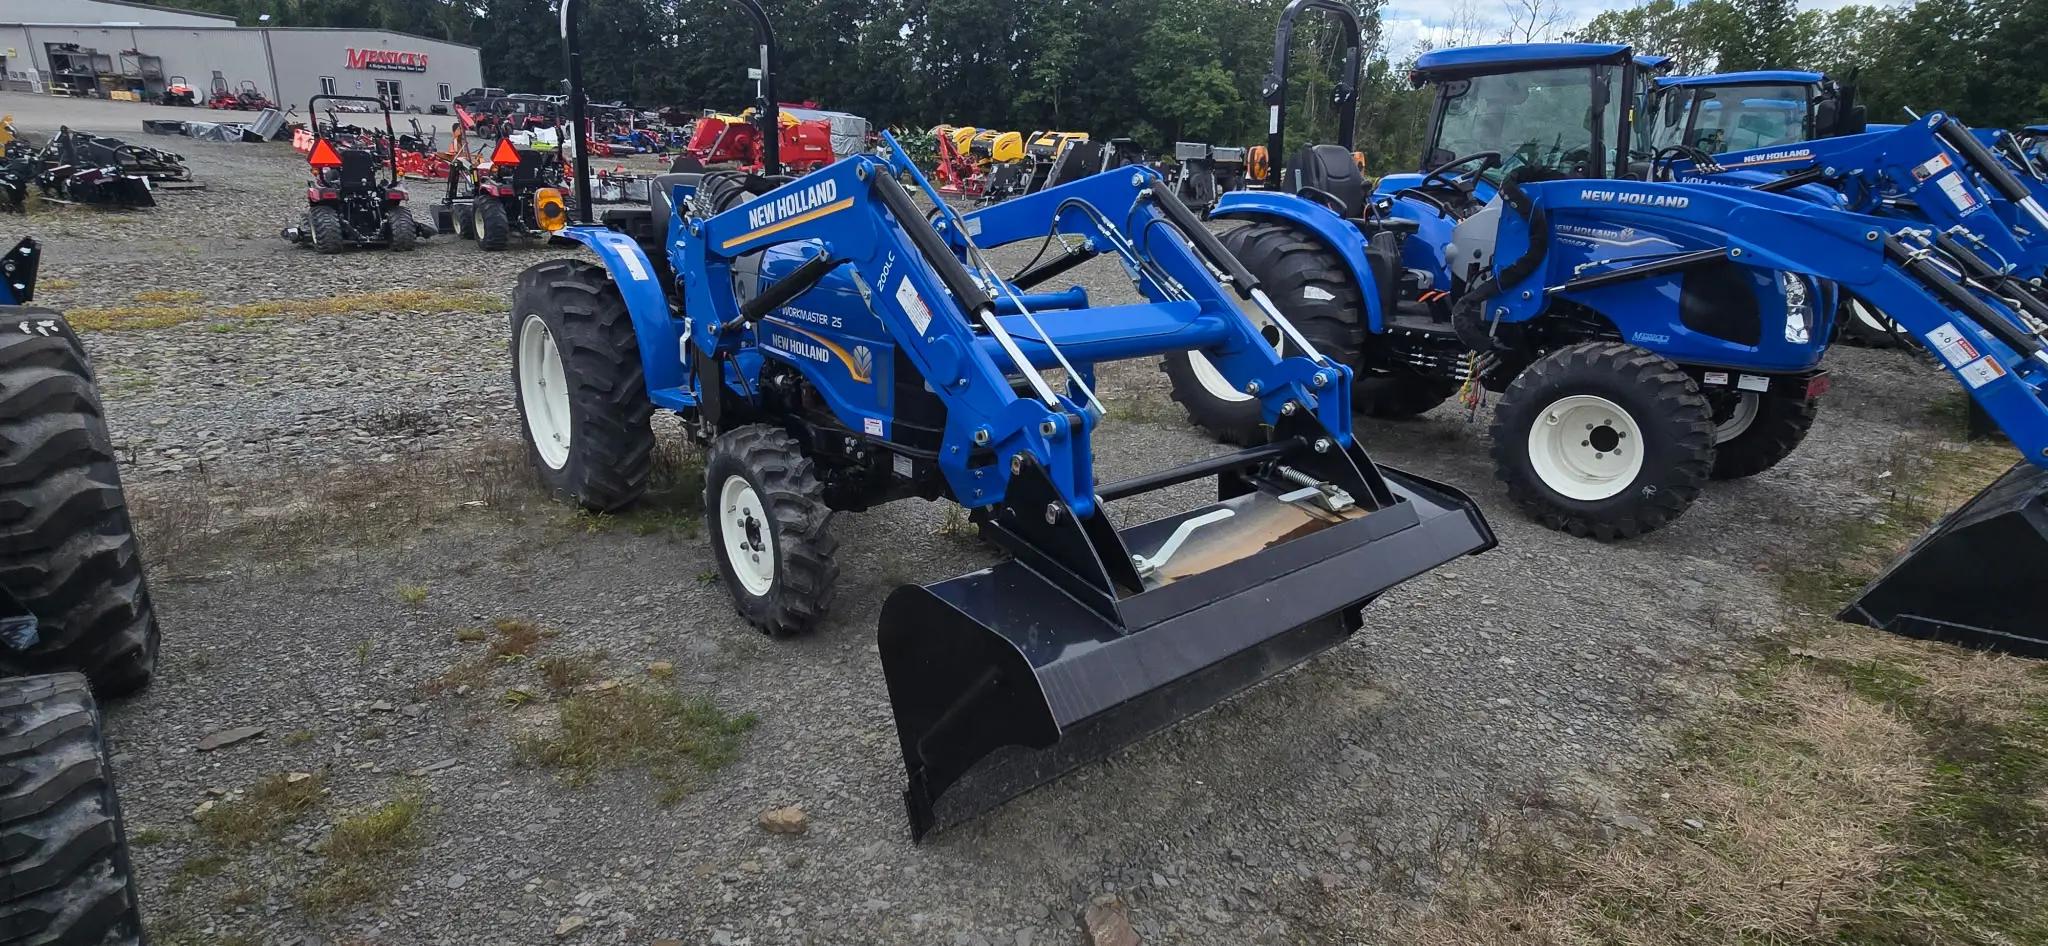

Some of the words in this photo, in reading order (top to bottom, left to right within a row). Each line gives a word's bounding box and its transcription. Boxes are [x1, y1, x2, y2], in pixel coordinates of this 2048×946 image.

[344, 48, 429, 70] MESSICK'S
[1743, 155, 1765, 163] NEW
[1766, 149, 1810, 160] HOLLAND
[749, 201, 775, 230] NEW
[777, 178, 837, 219] HOLLAND
[1581, 190, 1615, 201] NEW
[1617, 192, 1689, 208] HOLLAND
[1574, 226, 1618, 239] HOLLAND
[877, 250, 895, 292] 200LC
[782, 306, 828, 325] WORKMASTER
[831, 316, 843, 328] 25
[772, 333, 789, 351] NEW
[789, 340, 829, 363] HOLLAND
